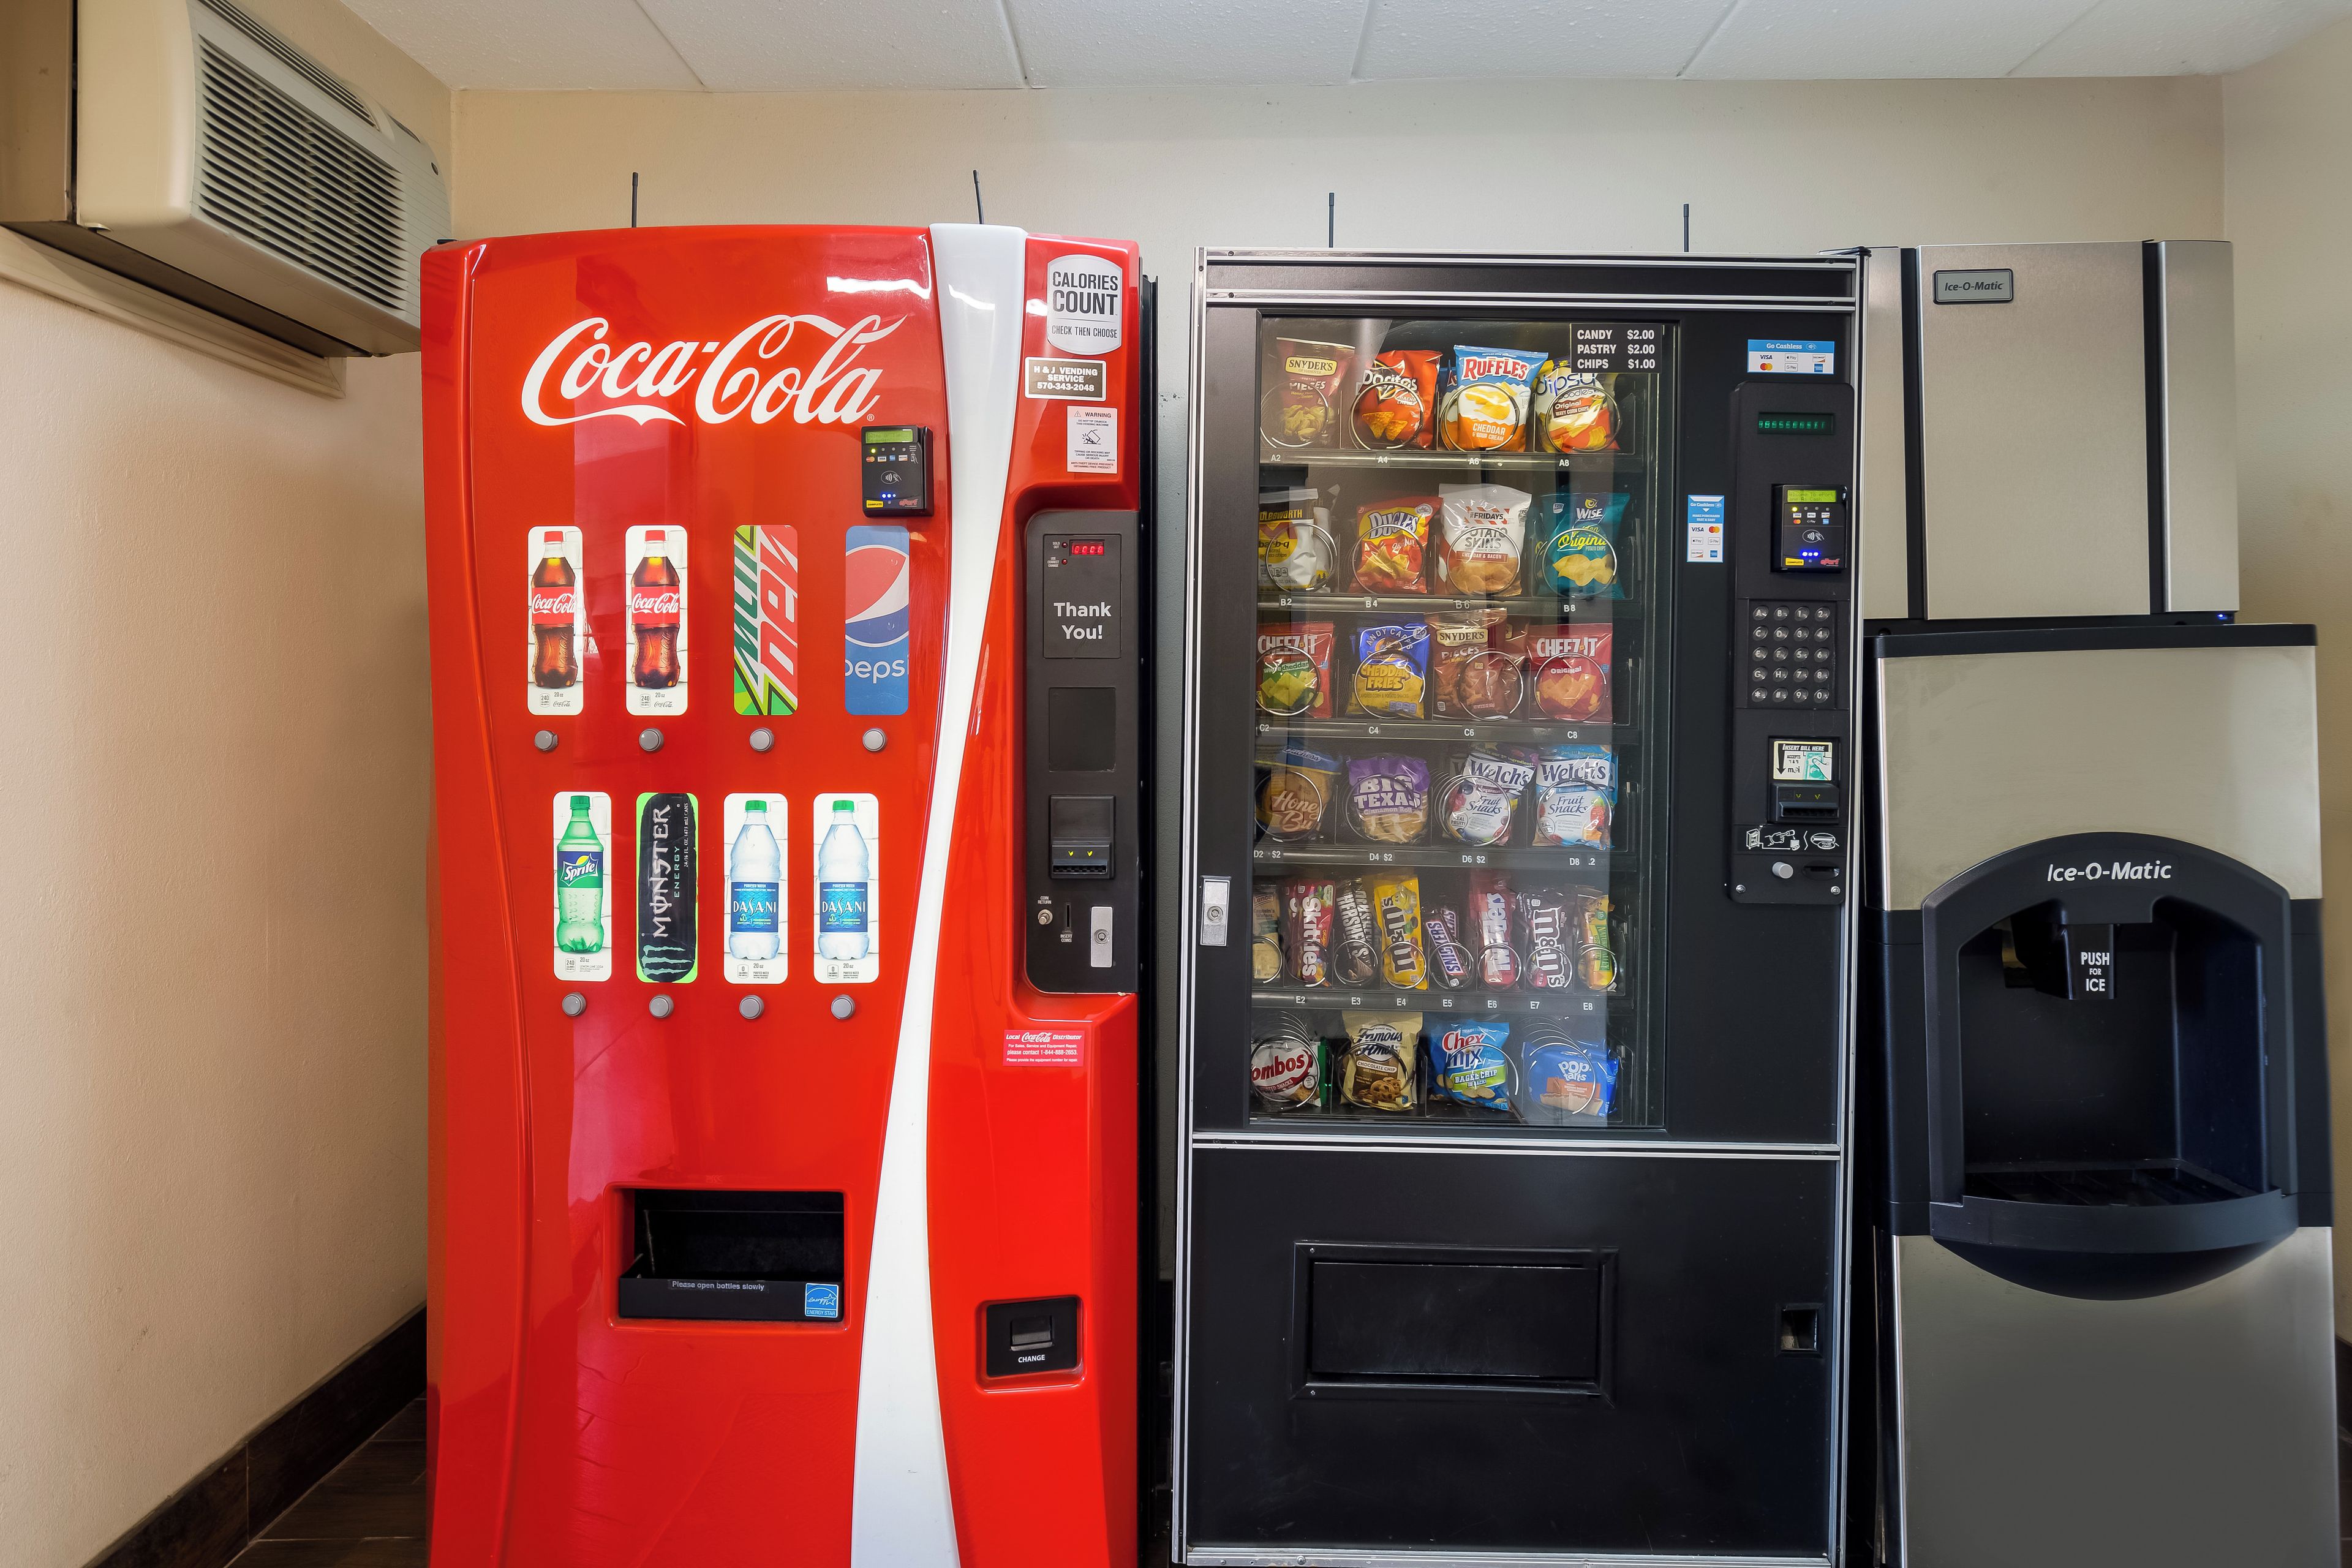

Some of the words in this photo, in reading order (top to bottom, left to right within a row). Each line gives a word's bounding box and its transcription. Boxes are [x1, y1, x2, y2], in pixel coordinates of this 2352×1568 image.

[1052, 271, 1118, 291] CALORIES
[1945, 281, 2004, 291] Ice-O-Matic
[1052, 290, 1118, 315] COUNT
[1052, 325, 1072, 335] CHECK
[1075, 326, 1091, 337] THEN
[1093, 326, 1118, 339] CHOOSE
[1577, 330, 1613, 339] CANDY
[1627, 330, 1655, 341] $2.00
[1577, 344, 1617, 354] PASTRY
[1627, 344, 1656, 355] $2.00
[521, 314, 908, 426] Coca-Cola
[1289, 359, 1333, 371] SNYDER'S
[1463, 358, 1528, 380] RUFFLES
[1577, 359, 1609, 369] CHIPS
[1627, 359, 1656, 369] $1.00
[1047, 374, 1085, 383] SERVICE
[1059, 367, 1098, 377] VENDING
[1363, 369, 1417, 391] Doritos
[1036, 382, 1095, 393] 570-343-2048
[1555, 400, 1581, 410] Original
[1472, 423, 1506, 436] CHEDDAR
[1576, 508, 1604, 519] WISE
[1258, 540, 1290, 549] bar-b-q
[1465, 537, 1501, 549] SKINS
[632, 592, 680, 614] Coca-Cola
[1054, 601, 1112, 617] Thank
[1061, 625, 1103, 639] You!
[1366, 628, 1387, 647] ANDY
[1439, 631, 1485, 641] SNYDER'S
[1441, 646, 1480, 660] PIECES
[1282, 662, 1309, 671] cheddar
[1366, 677, 1403, 690] FRIES
[1464, 728, 1475, 737] C6
[1470, 760, 1530, 786] Welch's
[1540, 761, 1606, 782] Welch's
[1359, 774, 1414, 794] BIG
[1354, 791, 1422, 809] TEXAS
[1478, 795, 1502, 805] Fruit
[1557, 796, 1585, 806] Fruit
[1363, 806, 1398, 815] Cinnamon
[1466, 801, 1502, 814] Snacks
[1547, 804, 1588, 815] Snacks
[564, 860, 595, 881] Sprite
[649, 804, 673, 938] MONSTER
[2047, 860, 2171, 881] Ice-O-Matic
[1254, 894, 1273, 904] Lance
[733, 897, 777, 916] DASANI
[822, 897, 866, 916] DASANI
[1302, 896, 1322, 976] Skittles
[2081, 952, 2110, 965] PUSH
[2086, 979, 2106, 992] ICE
[1021, 1032, 1053, 1042] Coca-Cola
[1352, 1030, 1403, 1044] Famous
[1443, 1031, 1485, 1051] Chex
[1251, 1054, 1305, 1082] ombos
[1357, 1061, 1383, 1071] CHOCOLATE
[1455, 1073, 1480, 1084] BAGEL
[1480, 1069, 1498, 1079] CHIP
[1563, 1072, 1587, 1082] tarts
[1276, 1079, 1294, 1090] SNACKS
[1018, 1354, 1046, 1363] CHANGE
